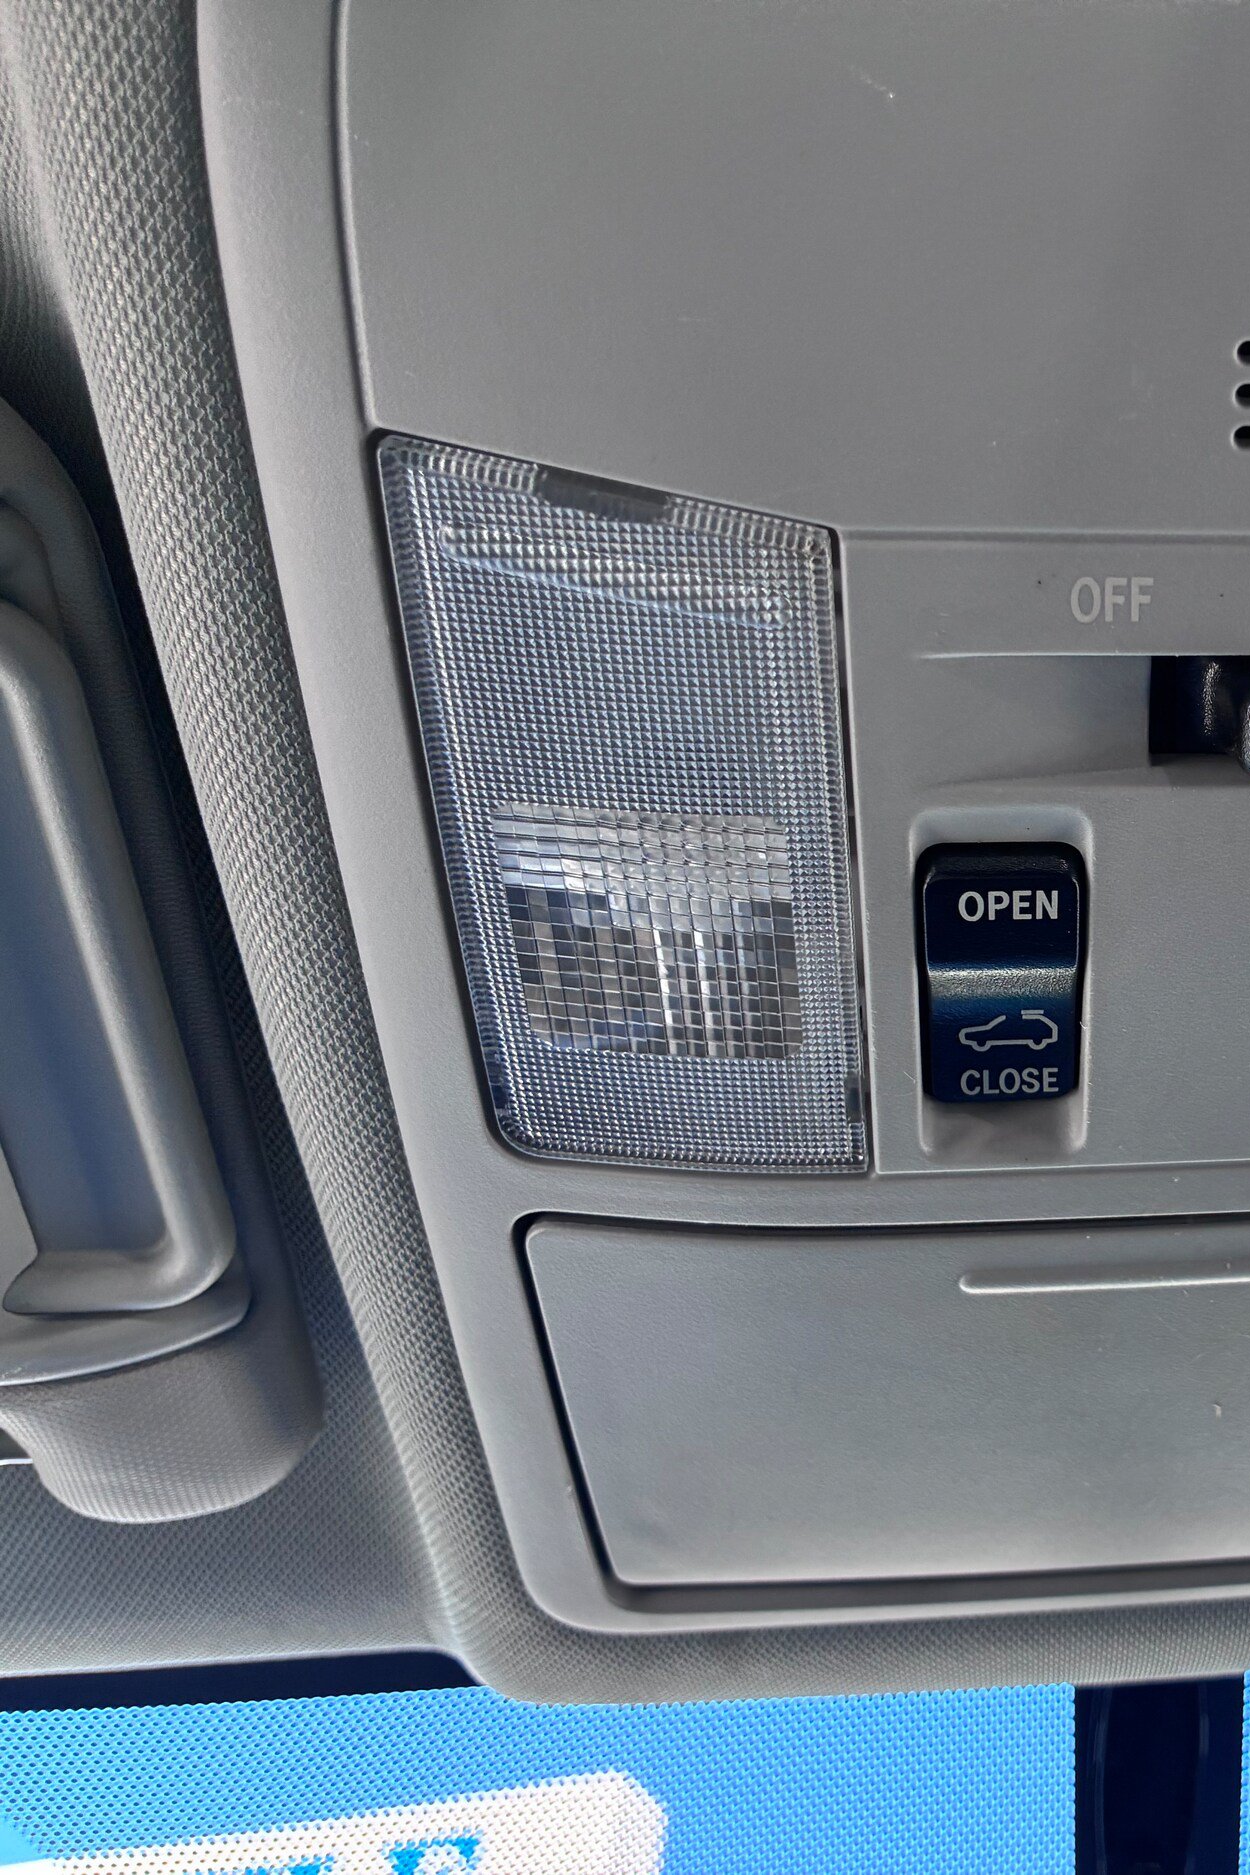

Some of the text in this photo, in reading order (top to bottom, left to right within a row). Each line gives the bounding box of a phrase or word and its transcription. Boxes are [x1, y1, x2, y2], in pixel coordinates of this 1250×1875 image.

[1070, 576, 1154, 623] OFF
[958, 889, 1059, 922] OPEN
[960, 1067, 1060, 1097] CLOSE
